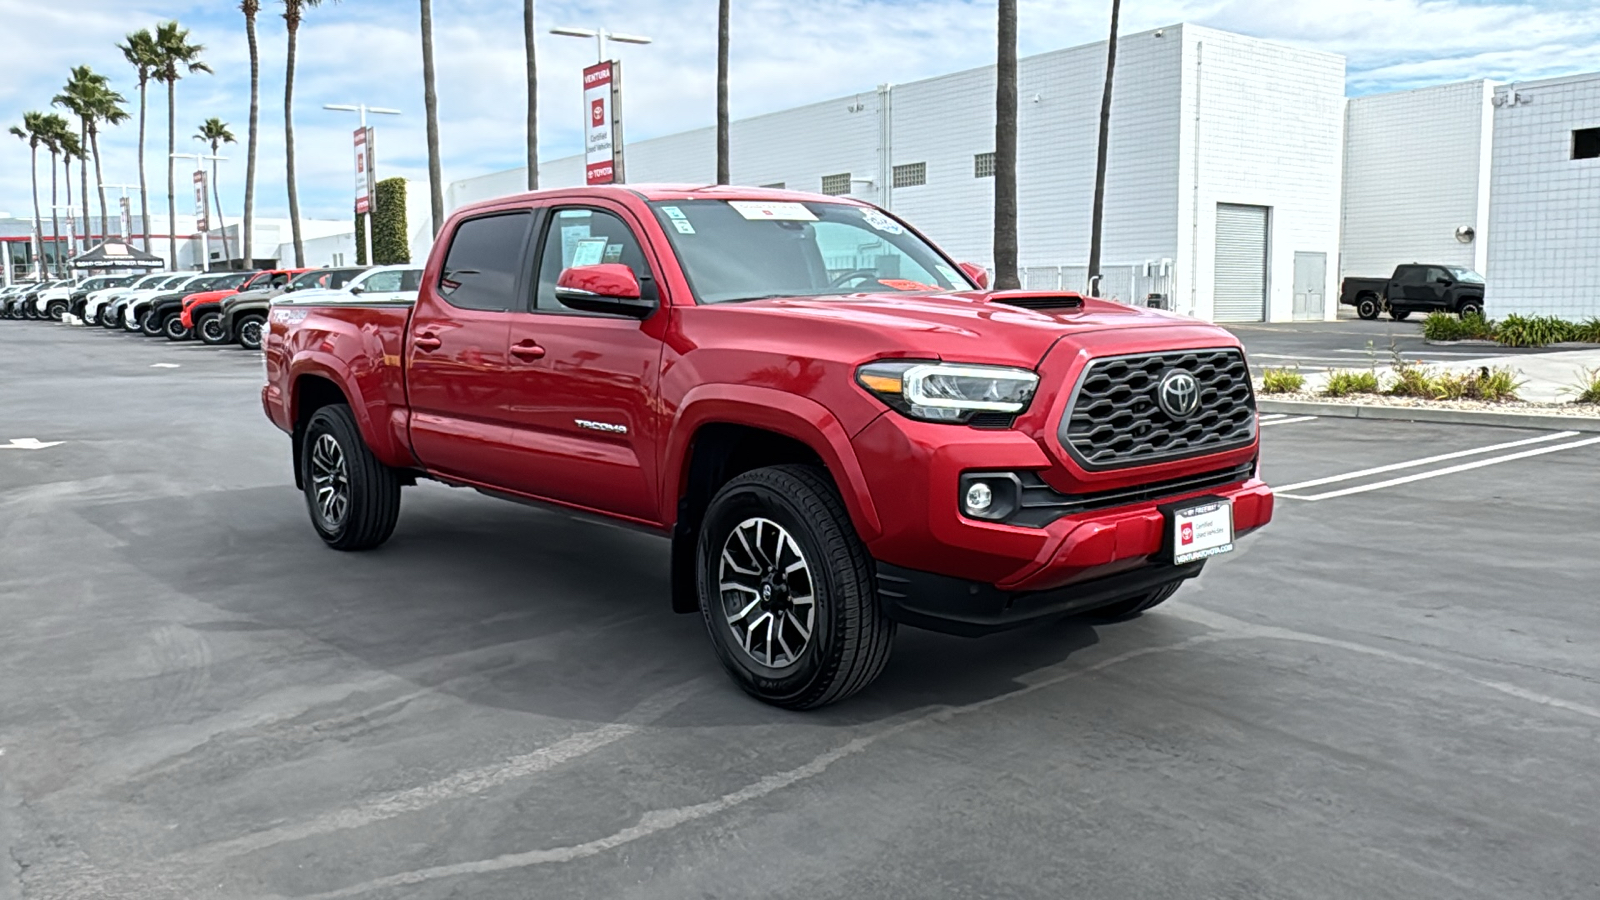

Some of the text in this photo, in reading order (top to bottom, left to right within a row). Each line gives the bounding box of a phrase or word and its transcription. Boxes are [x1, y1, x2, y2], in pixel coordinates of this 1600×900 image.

[585, 68, 610, 84] VENTURA
[593, 167, 613, 178] TOYOTA
[574, 419, 628, 434] TACOMA
[1195, 520, 1213, 530] Certified
[1176, 543, 1233, 564] VENTURATOYOTA.COM
